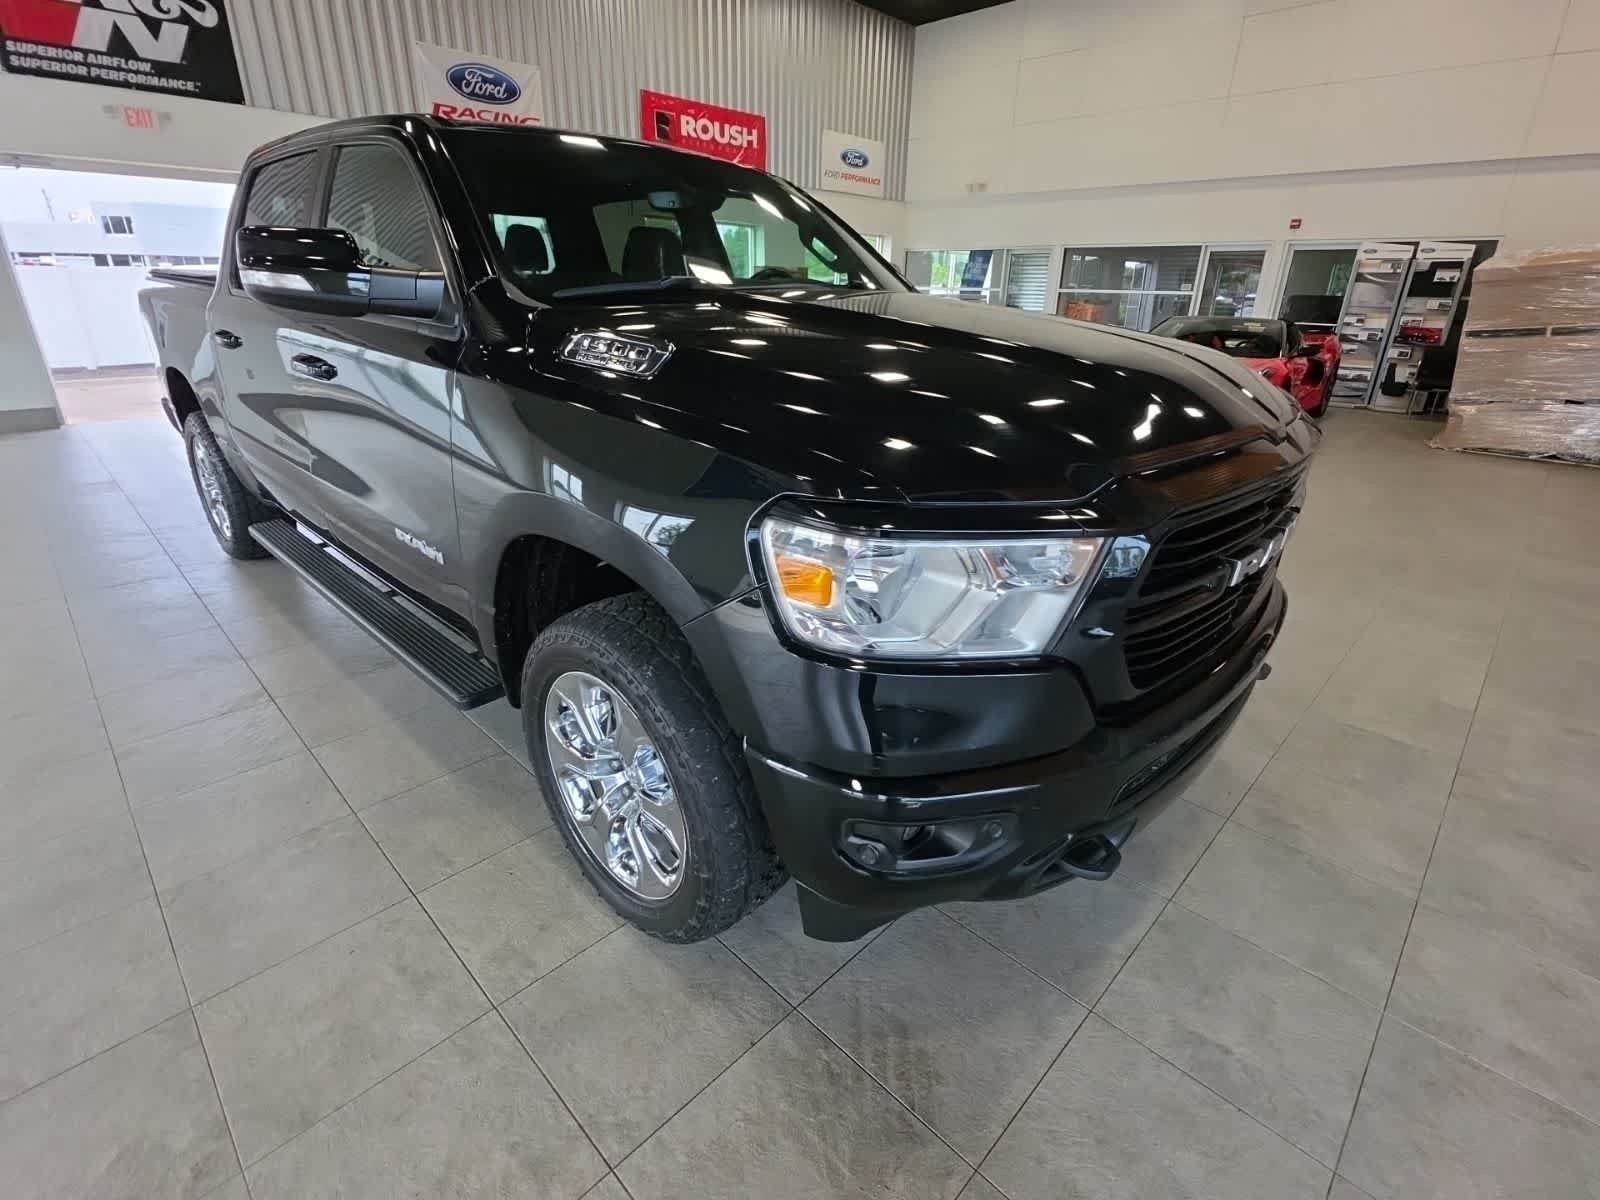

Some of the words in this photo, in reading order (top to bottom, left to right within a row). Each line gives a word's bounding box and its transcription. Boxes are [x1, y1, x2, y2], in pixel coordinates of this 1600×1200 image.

[5, 40, 85, 62] SUPERIOR
[86, 52, 155, 73] AIRFLOW.
[9, 54, 88, 76] SUPERIOR
[461, 68, 508, 98] Ford
[680, 114, 758, 149] ROUSH
